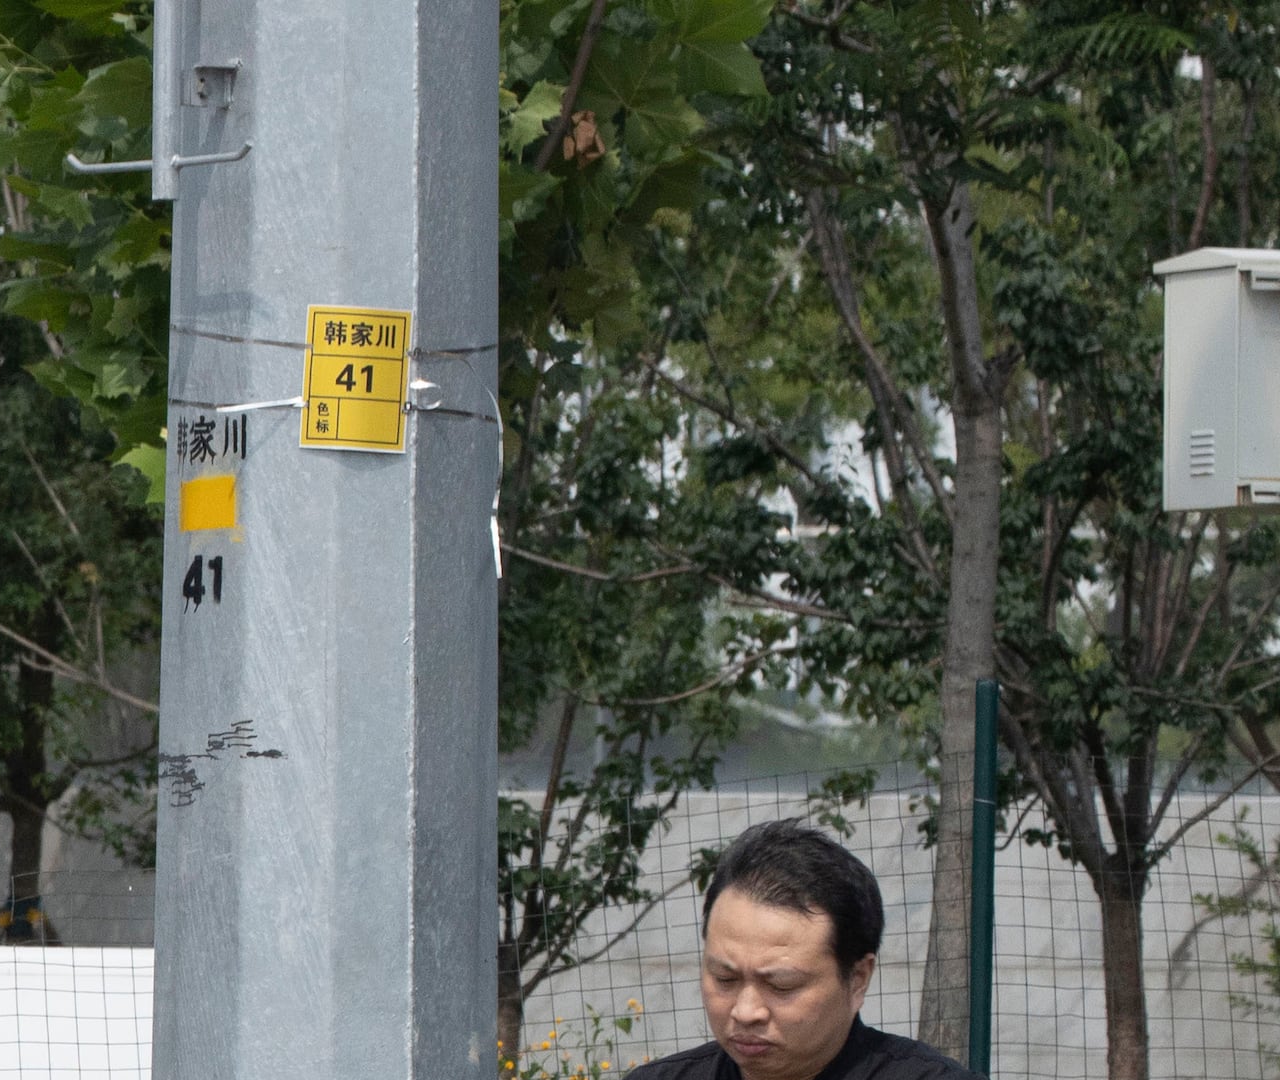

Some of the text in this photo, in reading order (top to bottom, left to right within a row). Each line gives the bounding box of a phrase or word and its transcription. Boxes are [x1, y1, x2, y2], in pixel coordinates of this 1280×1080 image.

[323, 320, 397, 349] 韩家川
[335, 363, 374, 393] 41
[316, 401, 330, 433] 色标
[183, 555, 223, 608] 41
